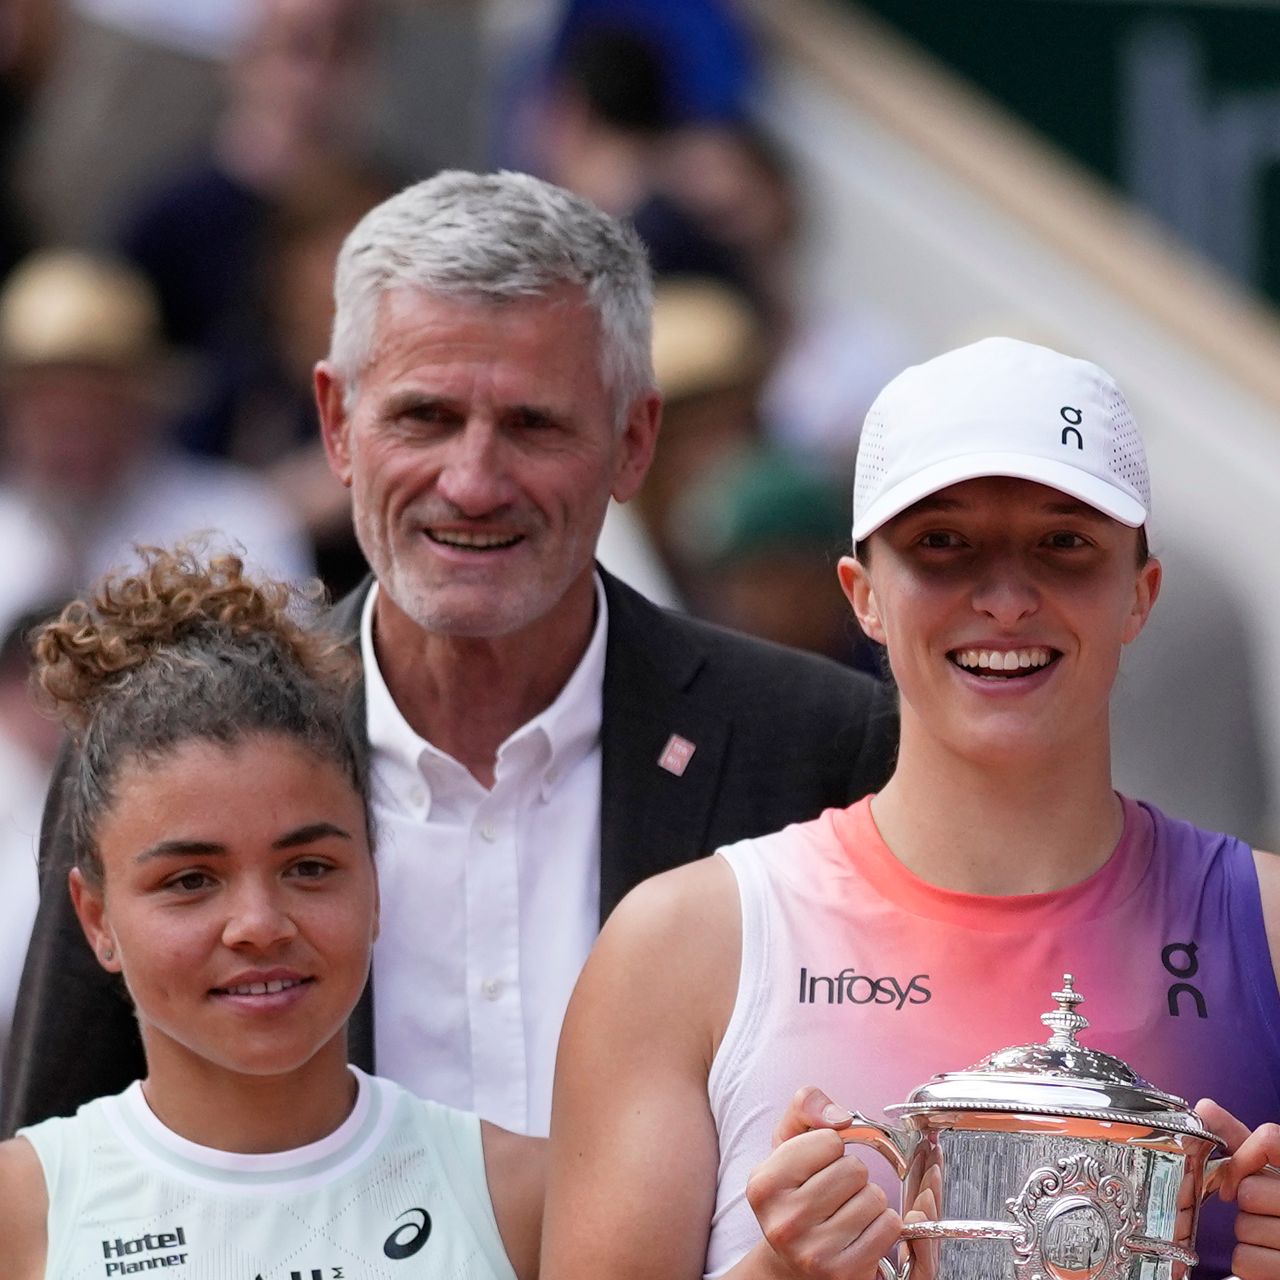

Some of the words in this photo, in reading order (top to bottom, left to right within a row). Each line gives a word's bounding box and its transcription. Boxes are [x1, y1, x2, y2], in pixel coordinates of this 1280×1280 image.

[798, 967, 932, 1011] Infosys
[102, 1226, 186, 1259] Hotel
[105, 1252, 188, 1277] Planner
